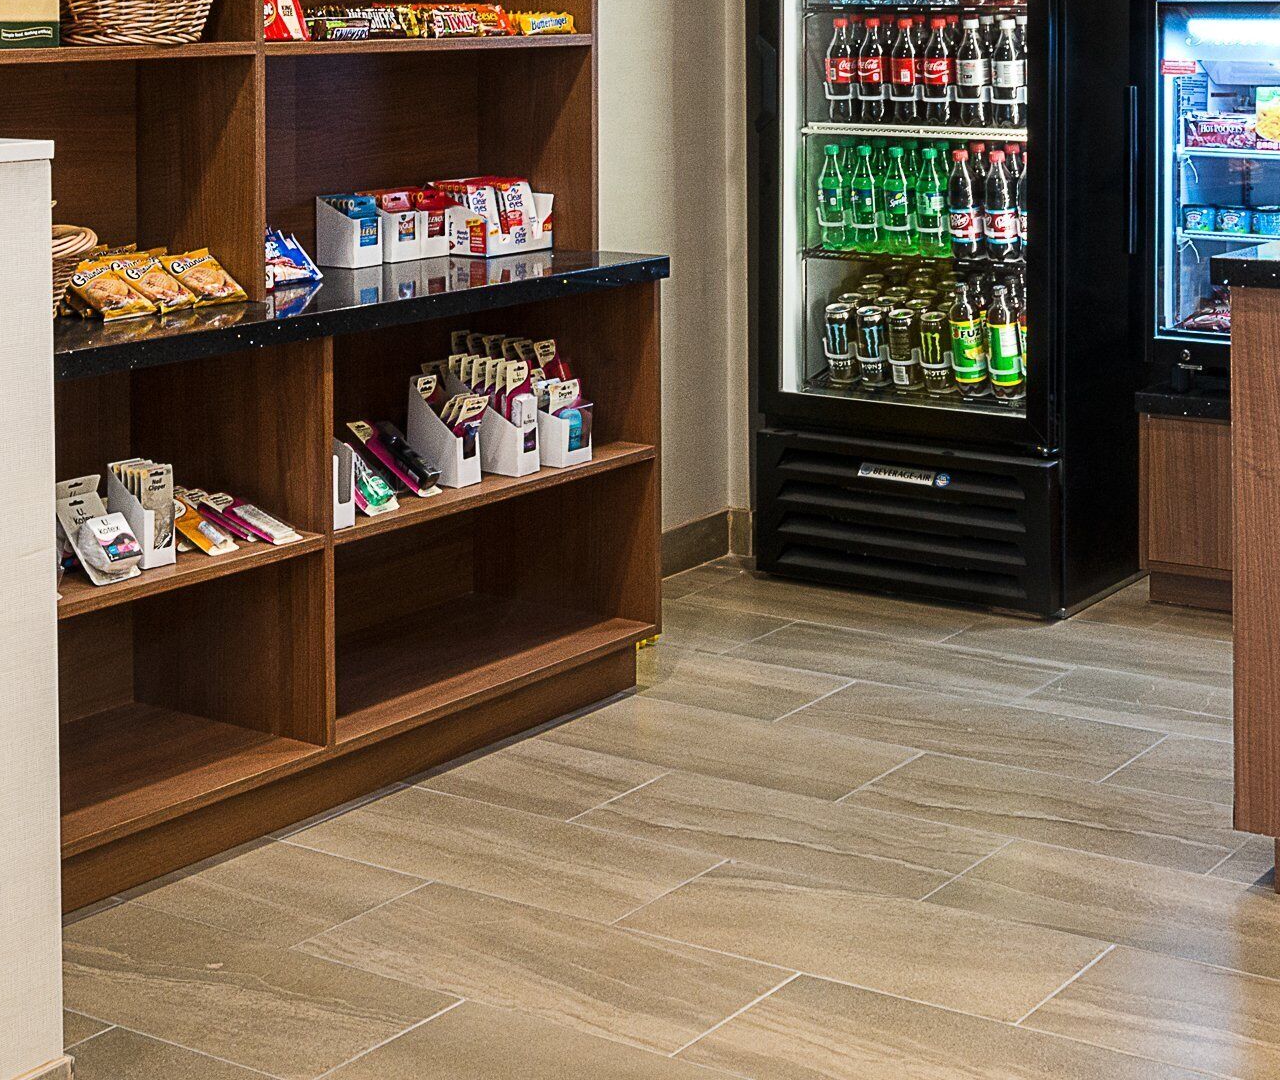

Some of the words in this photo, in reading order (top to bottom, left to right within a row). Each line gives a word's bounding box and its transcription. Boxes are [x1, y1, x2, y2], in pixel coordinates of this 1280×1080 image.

[445, 13, 478, 32] TWIX
[507, 193, 522, 202] Clear
[509, 201, 523, 210] eyes
[960, 328, 982, 339] FUZ
[873, 468, 931, 482] BEVERAGE-AIR
